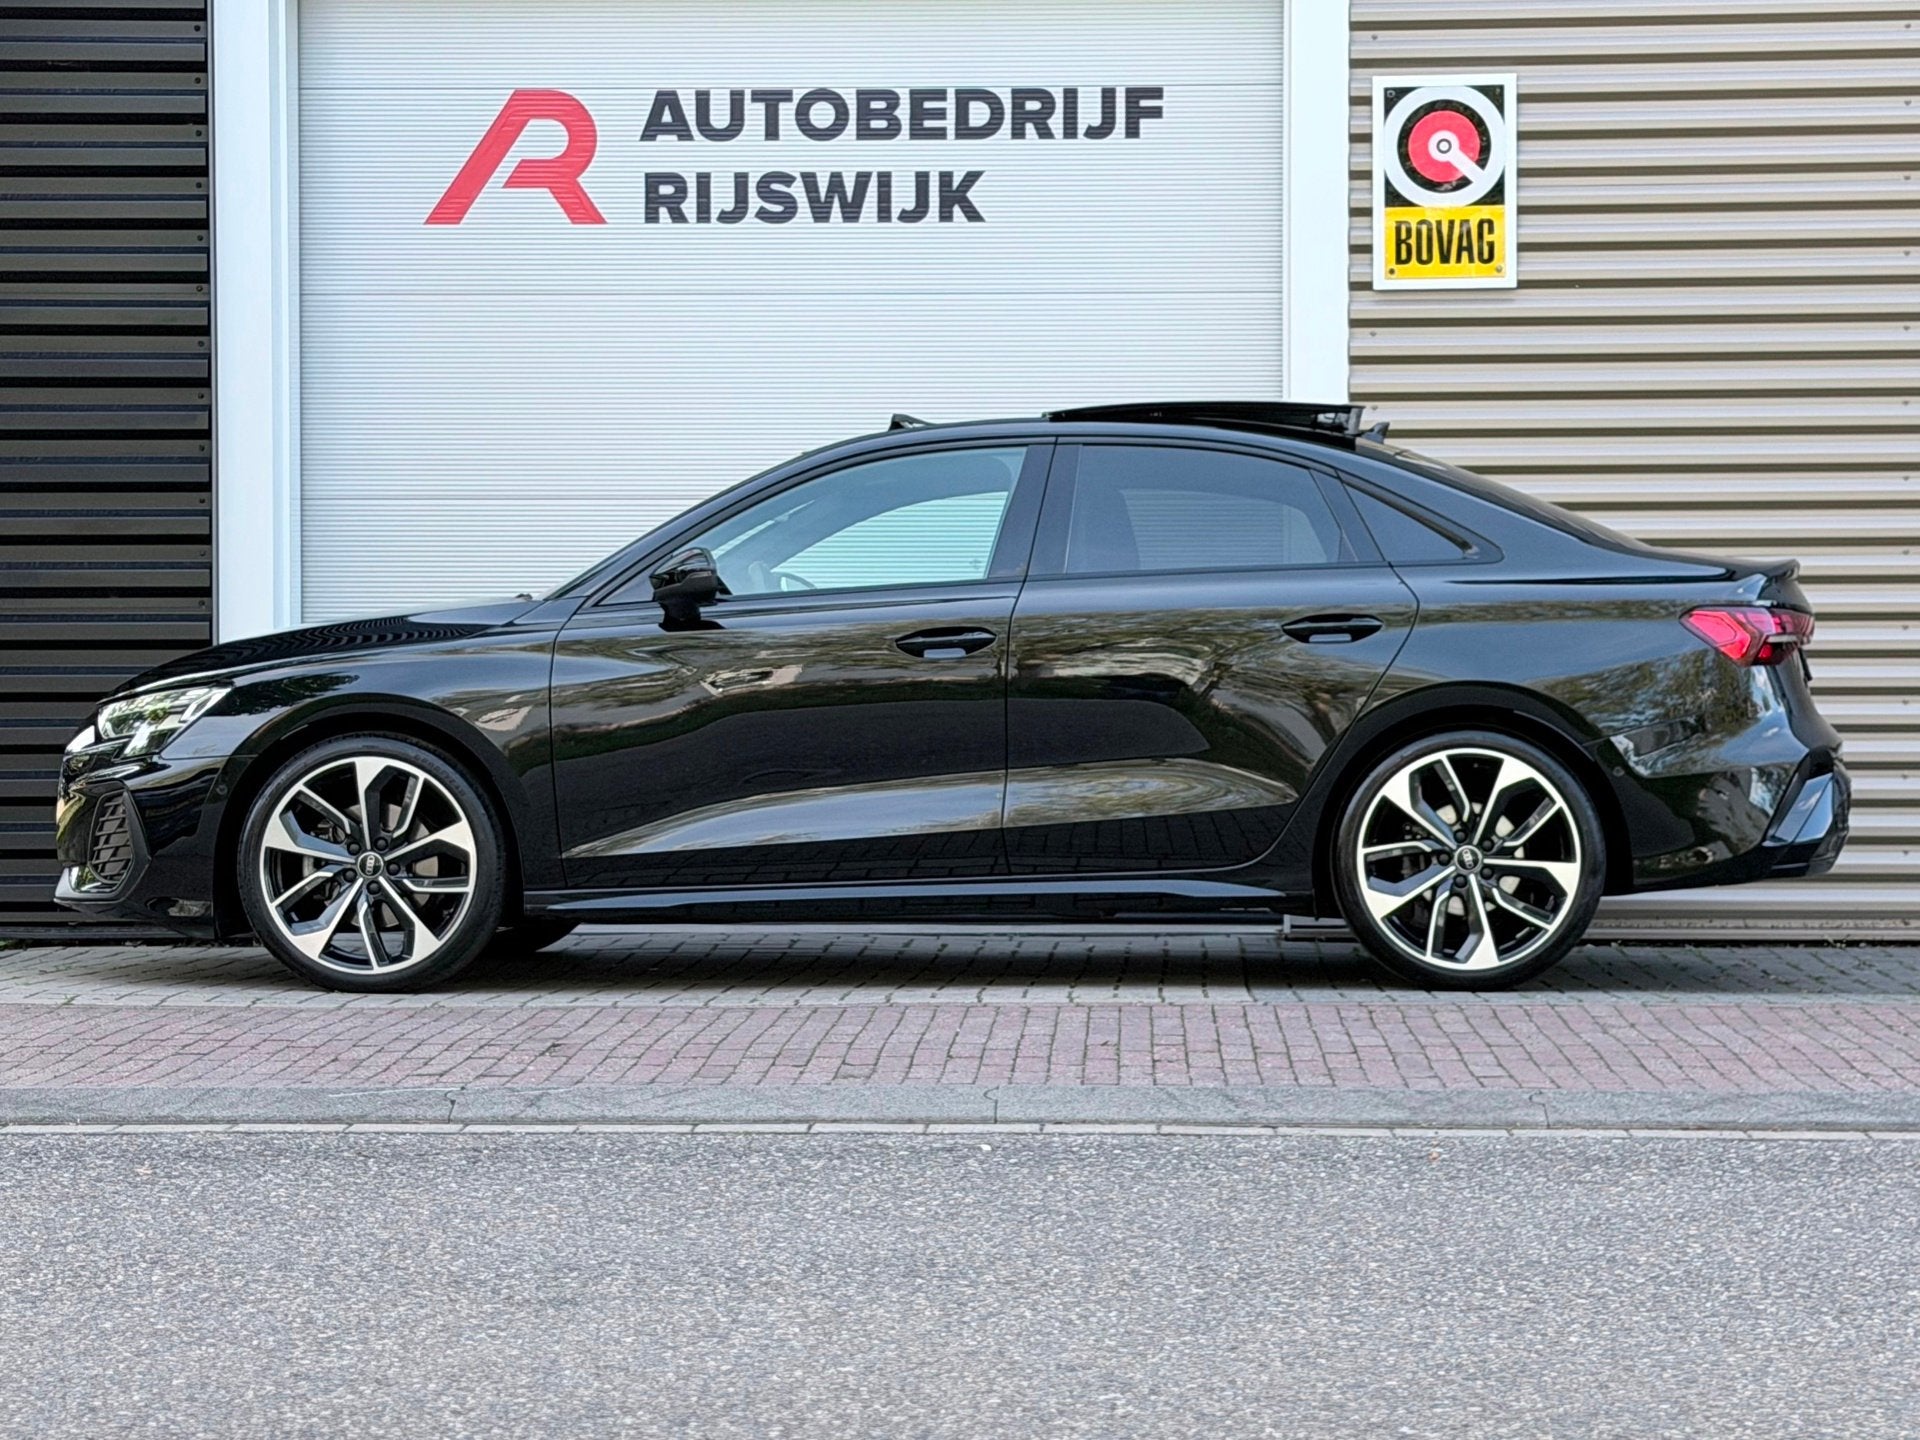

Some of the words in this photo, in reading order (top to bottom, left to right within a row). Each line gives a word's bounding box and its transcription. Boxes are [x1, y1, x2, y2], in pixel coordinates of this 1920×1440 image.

[640, 87, 1164, 142] AUTOBEDRIJF
[644, 171, 986, 225] RIJSWIJK
[1395, 218, 1496, 265] BOVAG
